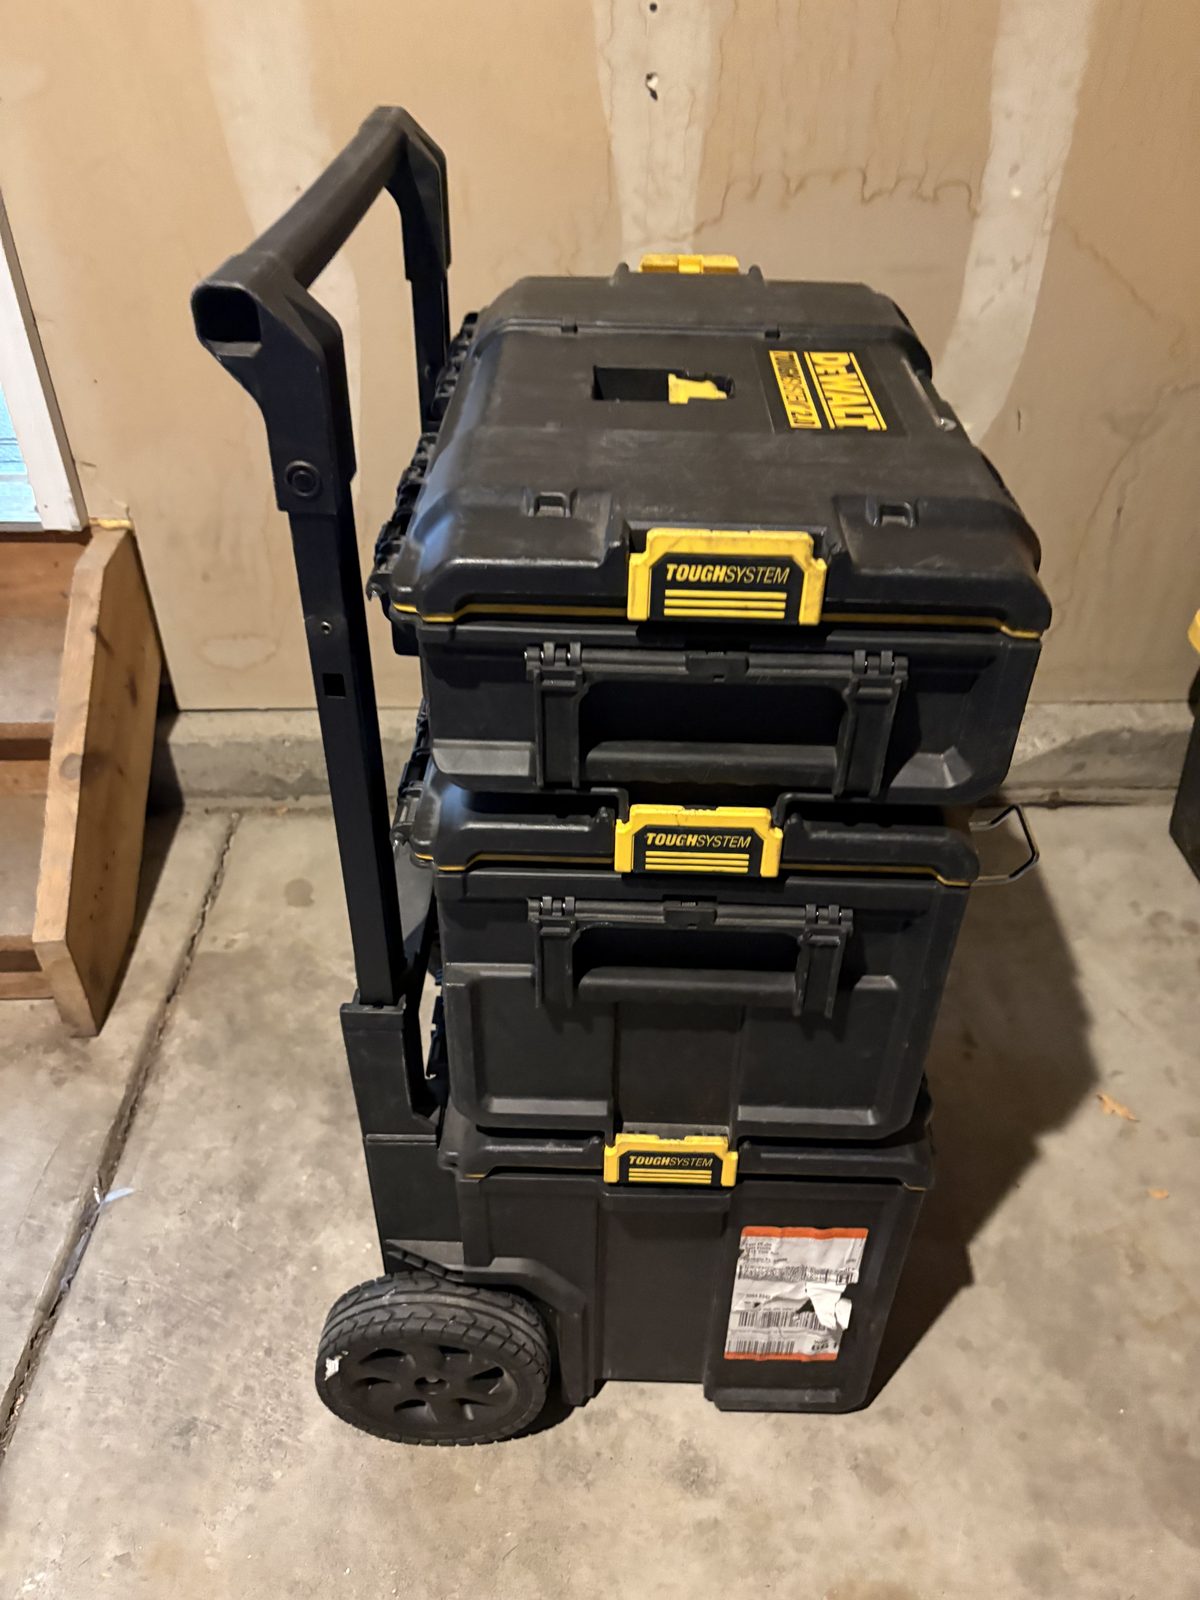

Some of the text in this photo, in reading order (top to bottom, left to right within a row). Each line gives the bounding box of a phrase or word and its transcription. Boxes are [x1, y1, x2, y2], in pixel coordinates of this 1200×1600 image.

[666, 563, 790, 584] TOUGHSYSTEM
[645, 832, 752, 849] TOUGHSYSTEM
[628, 1155, 713, 1167] TOUGHSYSTEM
